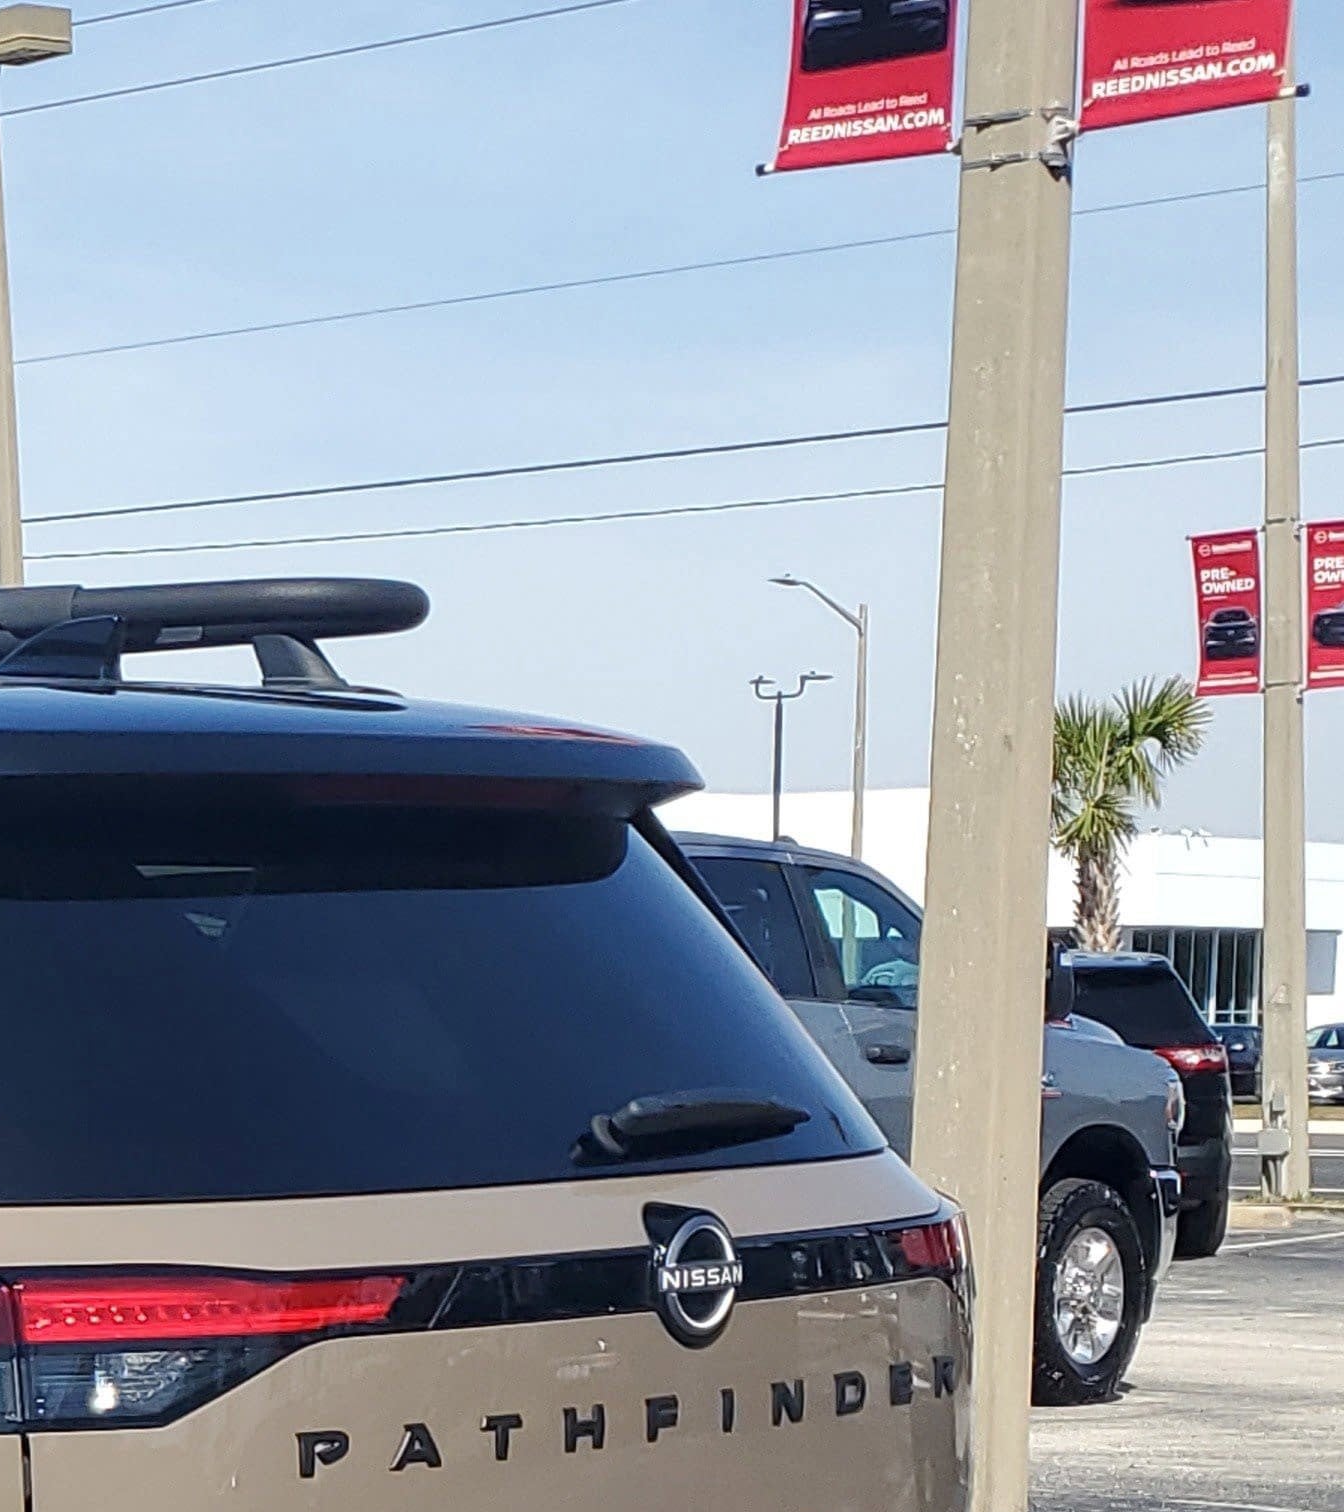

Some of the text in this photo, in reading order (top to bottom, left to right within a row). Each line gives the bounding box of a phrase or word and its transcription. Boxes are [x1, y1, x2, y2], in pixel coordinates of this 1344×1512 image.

[1130, 52, 1169, 68] Roads
[1171, 46, 1203, 62] Lead
[1205, 44, 1219, 57] to
[1222, 37, 1256, 54] Reed
[1091, 53, 1276, 99] REEDNISSAN.COM
[823, 104, 857, 119] Roads
[857, 99, 884, 114] Lead
[886, 98, 897, 108] to
[899, 93, 928, 107] Reed
[787, 108, 945, 145] REEDNISSAN.COM
[1200, 567, 1237, 582] PRE-
[1201, 578, 1255, 594] OWNED
[662, 1263, 744, 1290] NISSAN
[295, 1355, 960, 1479] PATHFINDER
